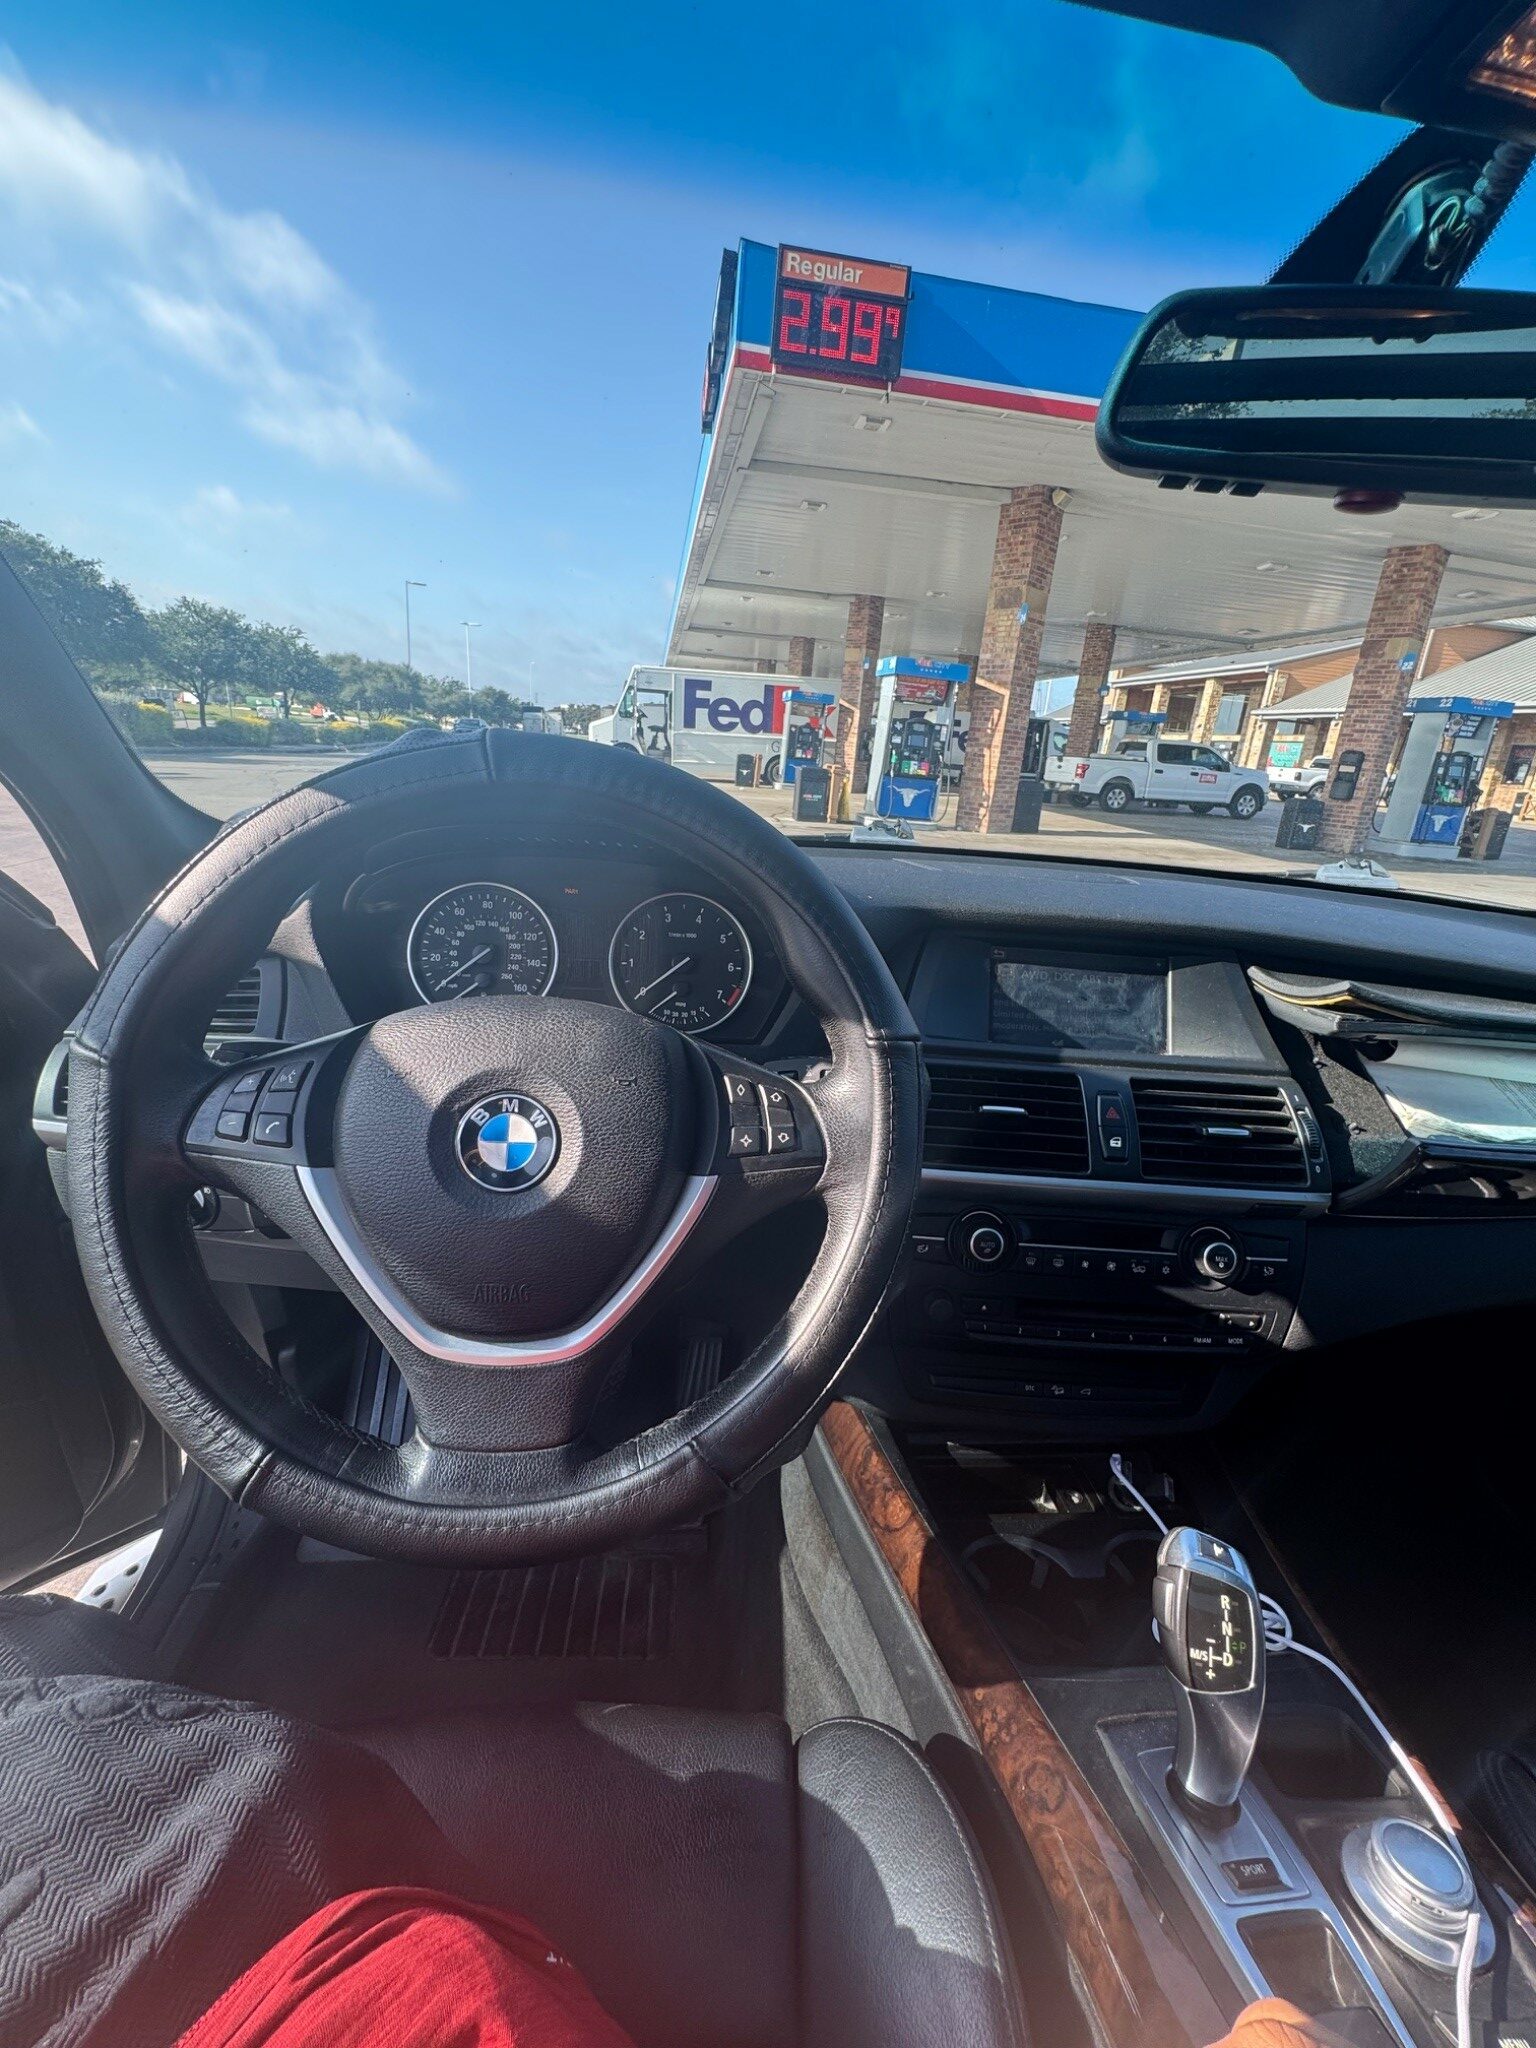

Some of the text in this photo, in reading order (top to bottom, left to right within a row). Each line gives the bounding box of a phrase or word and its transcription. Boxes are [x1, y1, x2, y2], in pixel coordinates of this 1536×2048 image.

[786, 252, 863, 284] Regular
[1439, 698, 1454, 707] 22
[482, 901, 493, 909] 80
[454, 907, 465, 916] 60
[509, 911, 522, 920] 100
[665, 913, 672, 922] 3
[695, 915, 702, 924] 4
[434, 927, 445, 936] 40
[639, 930, 646, 940] 2
[523, 932, 537, 941] 120
[720, 935, 726, 944] 5
[430, 953, 441, 962] 20
[526, 959, 541, 968] 140
[728, 963, 734, 972] 6
[513, 984, 527, 992] 160
[717, 990, 723, 999] 7
[470, 1098, 549, 1129] BMW
[1214, 1255, 1228, 1263] MAX
[472, 1281, 532, 1304] AIRBAG
[1227, 1337, 1244, 1345] MODE
[1220, 1594, 1231, 1610] R
[1221, 1620, 1233, 1636] N
[1222, 1651, 1233, 1667] D
[1240, 1863, 1267, 1877] SPORT
